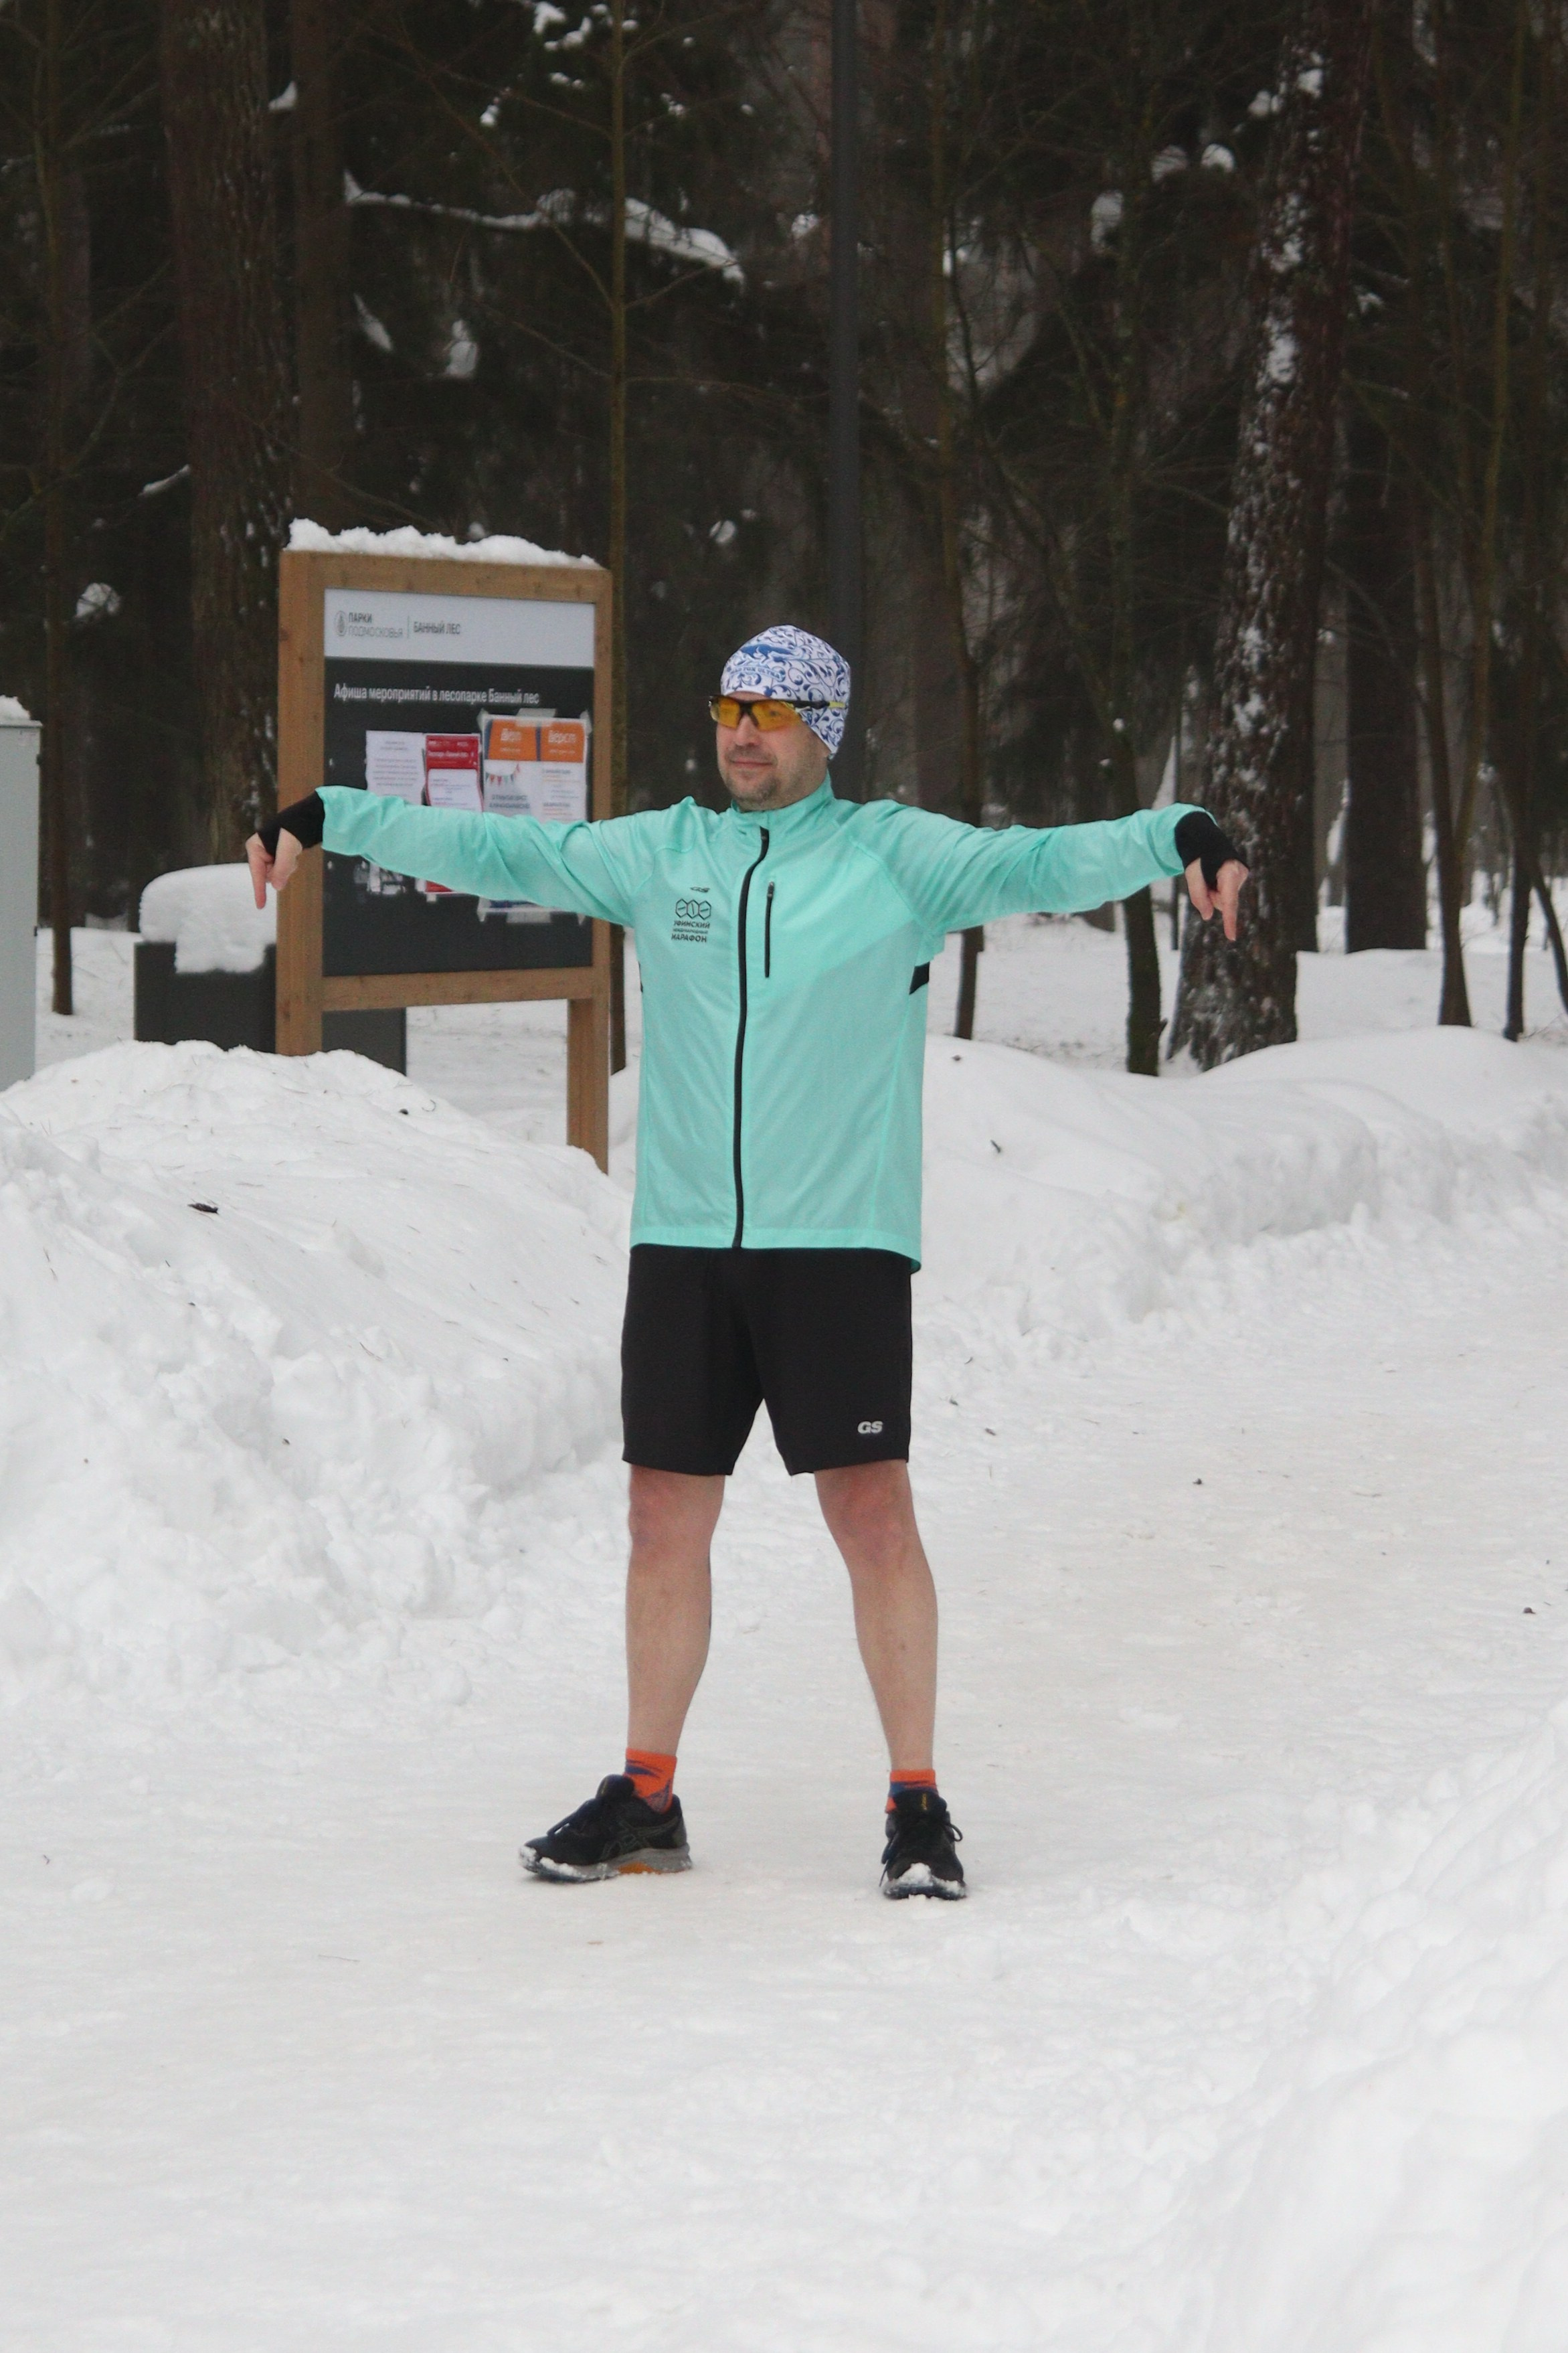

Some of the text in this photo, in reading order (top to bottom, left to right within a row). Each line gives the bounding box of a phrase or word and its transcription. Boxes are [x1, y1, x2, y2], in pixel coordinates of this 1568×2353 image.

[349, 612, 372, 623] ПАРКИ
[348, 625, 403, 638] ПОДМОСКОВЬЯ
[414, 621, 461, 635] БАННЫЙ ЛЕС
[334, 683, 539, 704] Афиша мероприятий в лесопарке Банный лес
[671, 933, 707, 943] МАРАФОН
[857, 1421, 883, 1434] GS
